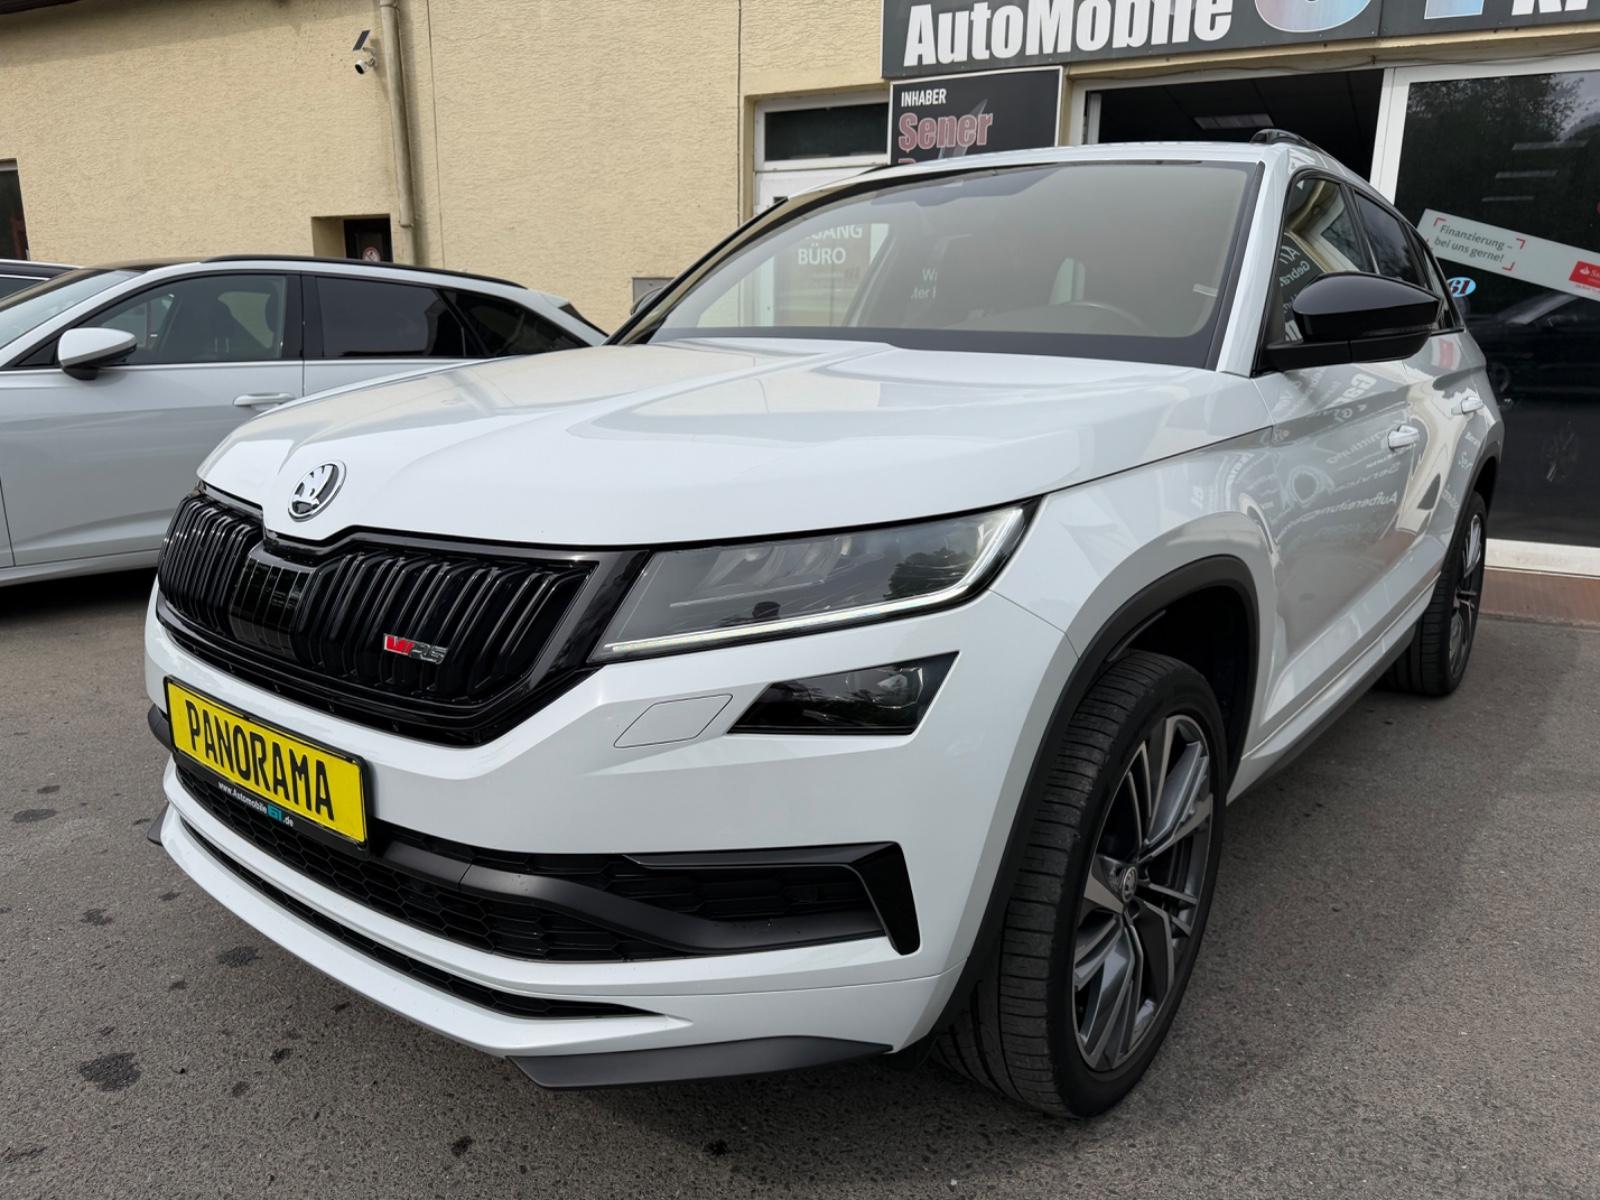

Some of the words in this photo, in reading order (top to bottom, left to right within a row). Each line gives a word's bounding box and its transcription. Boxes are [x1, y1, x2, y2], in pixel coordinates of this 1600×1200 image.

[903, 0, 1233, 67] AutoMobile
[900, 87, 948, 108] INHABER
[1434, 236, 1451, 248] bei
[1451, 242, 1470, 253] uns
[1469, 247, 1505, 263] gerne!
[1440, 224, 1505, 251] Finanzierung
[797, 242, 847, 265] BÜRO
[185, 699, 335, 822] PANORAMA
